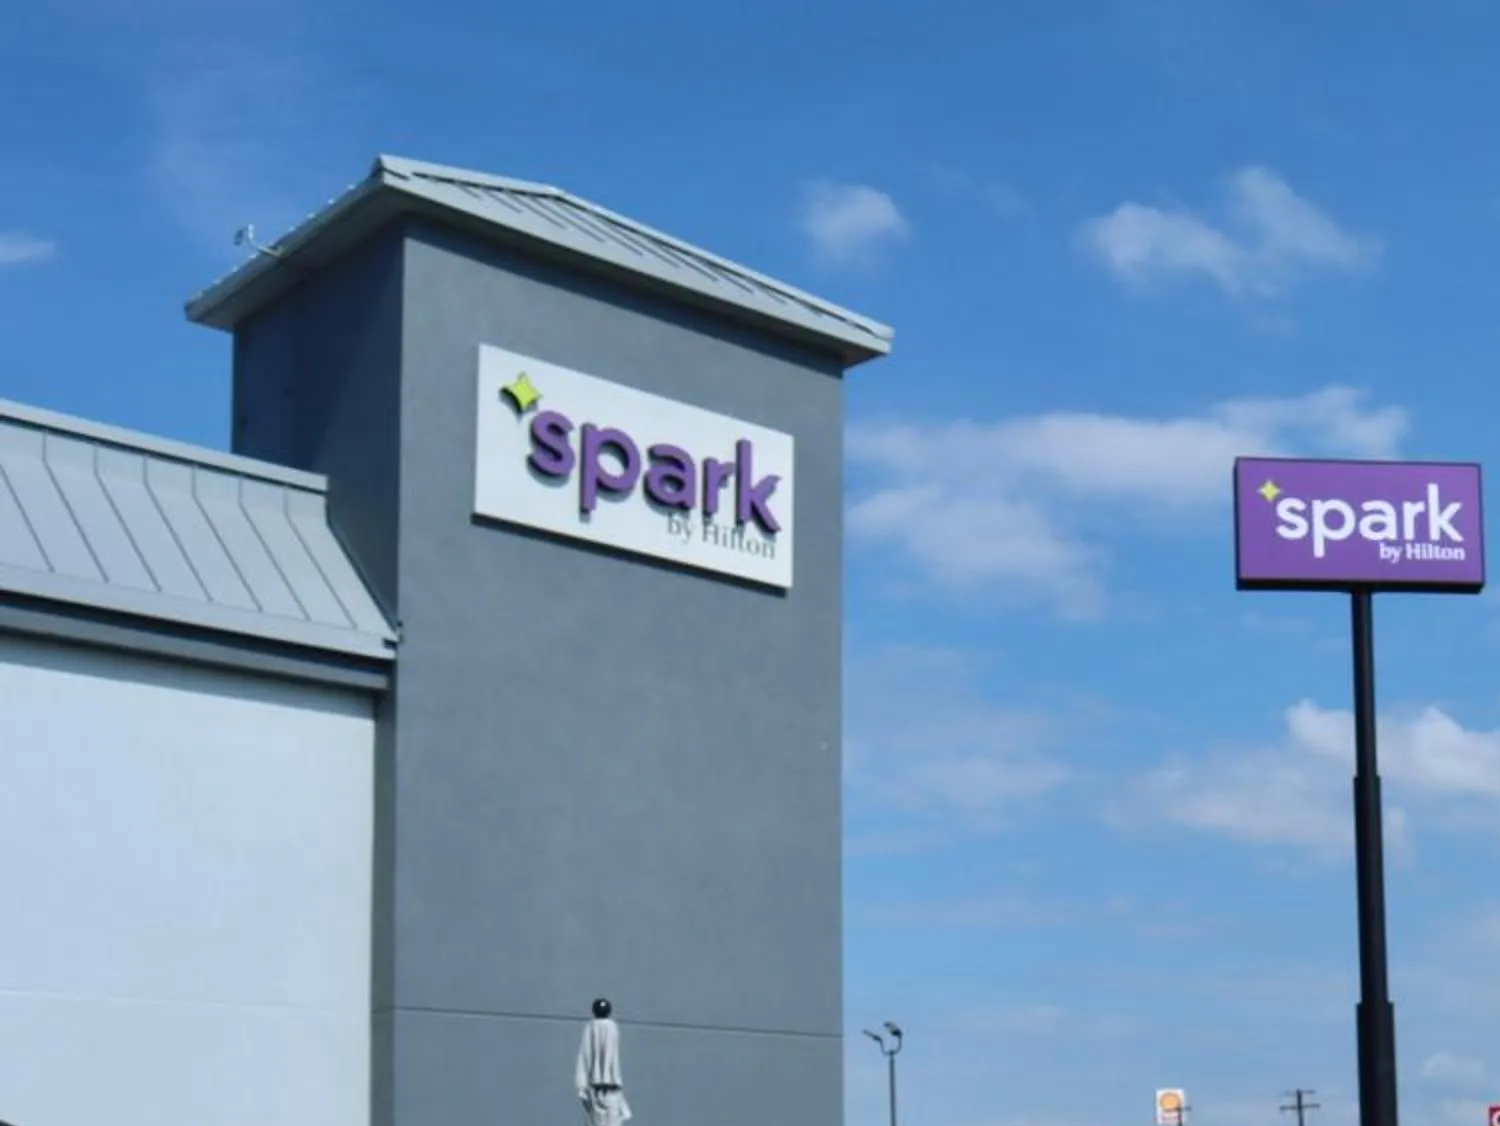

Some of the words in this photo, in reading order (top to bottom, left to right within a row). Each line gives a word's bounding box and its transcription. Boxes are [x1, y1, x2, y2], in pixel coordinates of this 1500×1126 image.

[526, 409, 783, 535] spark
[668, 510, 693, 544] by
[702, 520, 776, 561] Hilton
[1276, 483, 1464, 559] spark
[1380, 543, 1402, 564] by
[1405, 543, 1466, 561] Hilton
